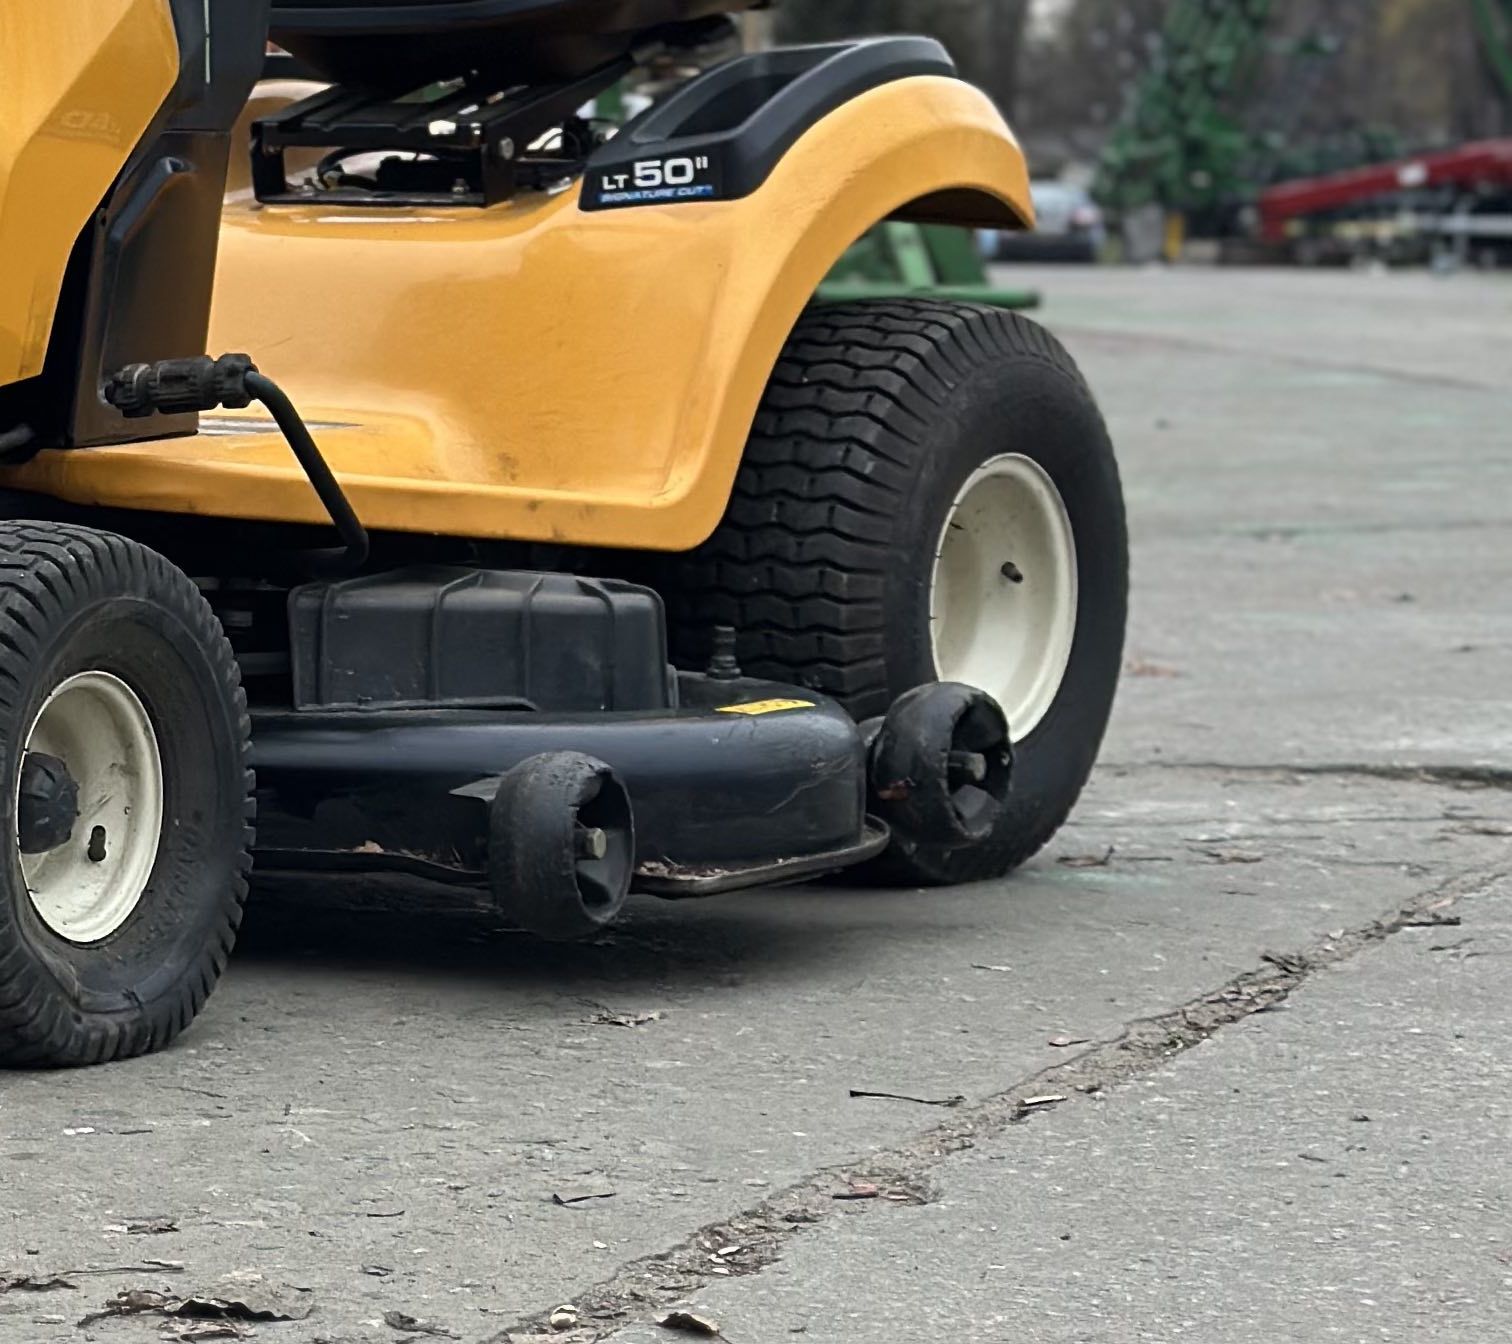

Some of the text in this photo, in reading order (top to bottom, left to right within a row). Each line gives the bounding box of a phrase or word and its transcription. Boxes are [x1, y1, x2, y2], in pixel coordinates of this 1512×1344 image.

[601, 156, 709, 190] LT 50"
[600, 185, 703, 203] SIGNATURE CUT
